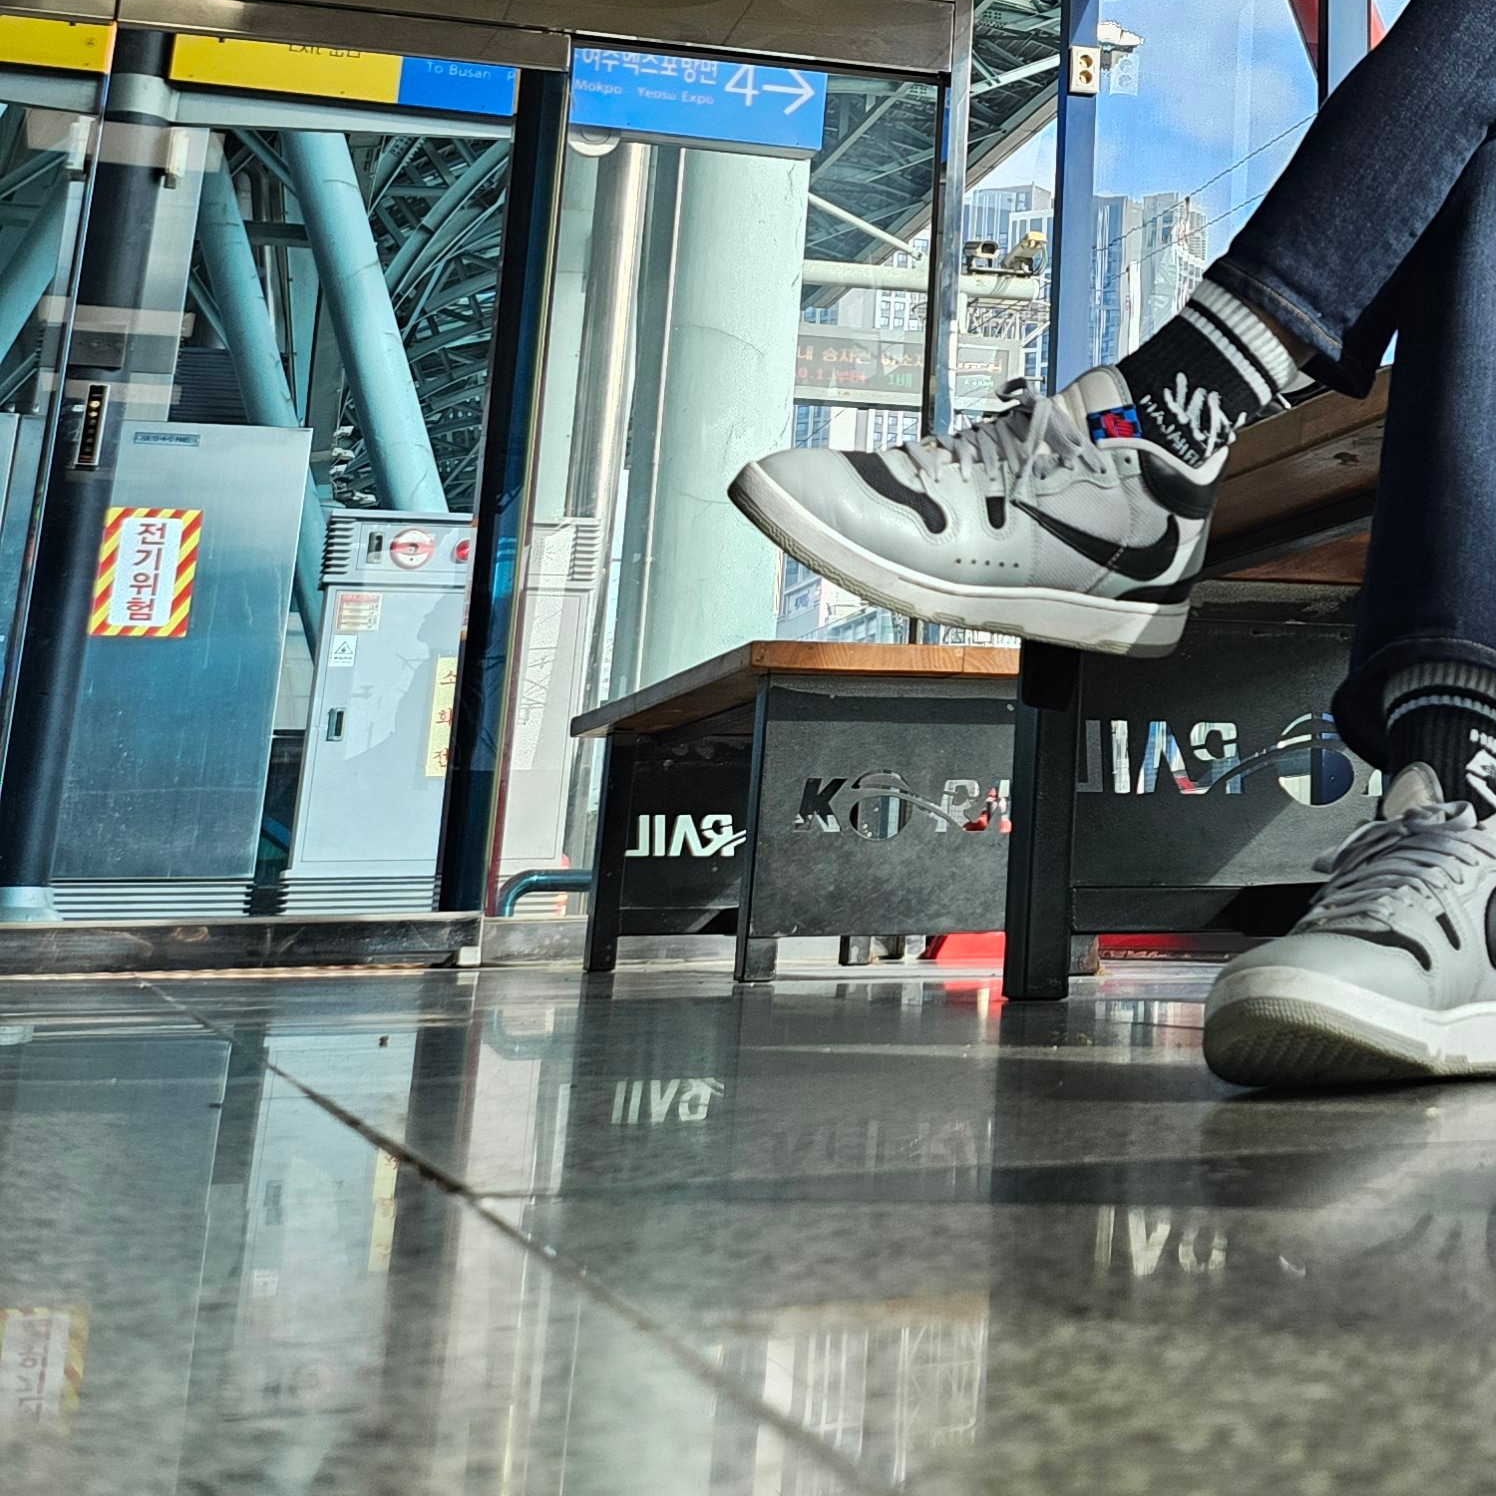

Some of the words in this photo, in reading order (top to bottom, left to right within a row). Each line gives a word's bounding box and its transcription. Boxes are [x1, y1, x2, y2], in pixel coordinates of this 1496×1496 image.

[426, 61, 443, 75] To
[448, 64, 491, 80] Busan
[574, 79, 623, 95] Mokpo
[637, 86, 677, 101] Yeosu
[681, 91, 715, 105] Expo
[724, 64, 760, 107] 4
[126, 522, 168, 621] 전기위험
[792, 768, 1012, 842] KORA
